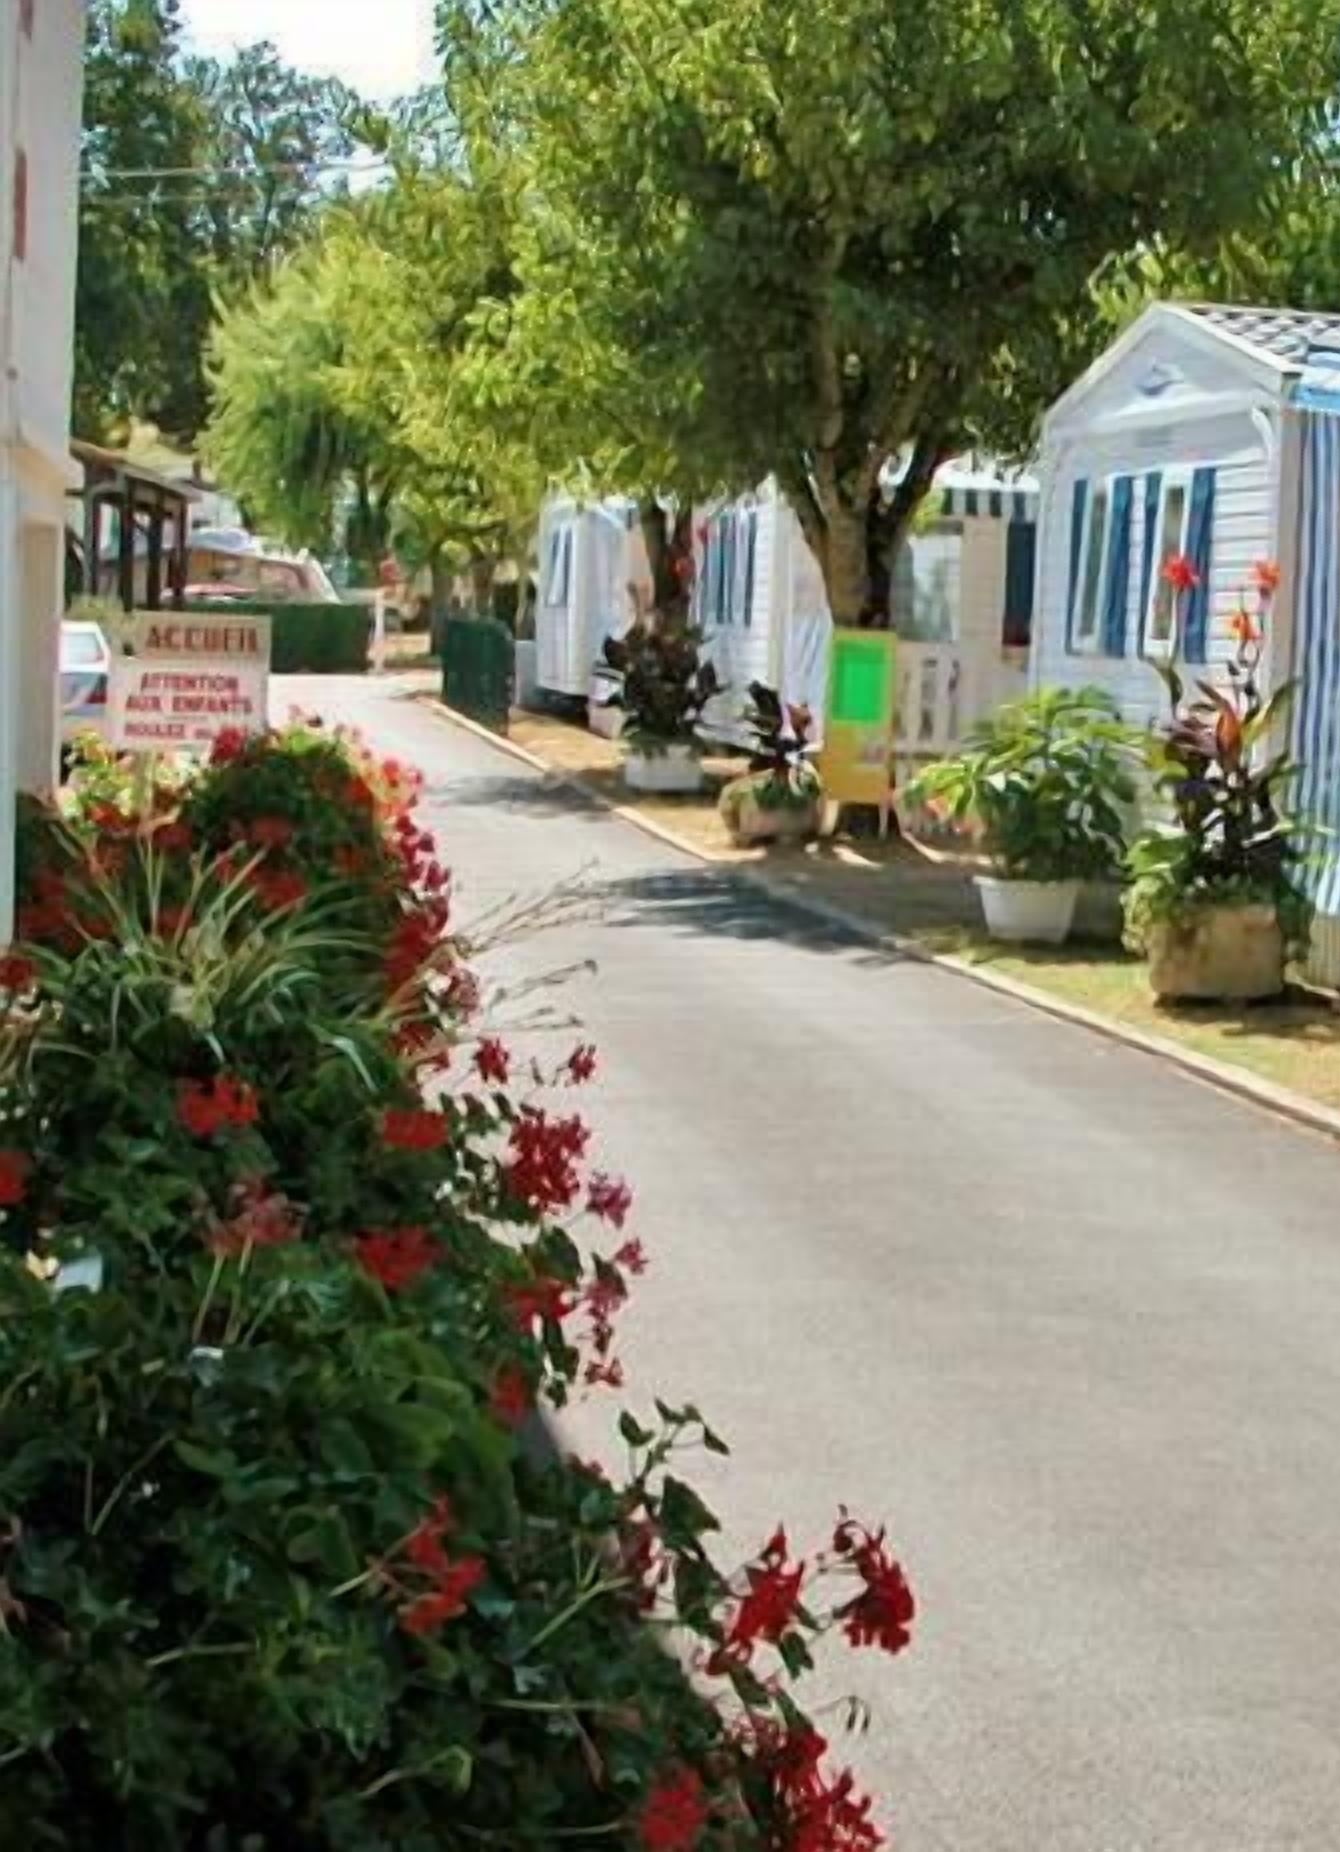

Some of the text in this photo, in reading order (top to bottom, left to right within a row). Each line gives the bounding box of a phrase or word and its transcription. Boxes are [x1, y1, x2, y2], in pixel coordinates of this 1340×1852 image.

[145, 627, 257, 652] ACCUEIL
[141, 673, 239, 690] ATTENTION
[126, 696, 252, 713] AUX ENFANTS
